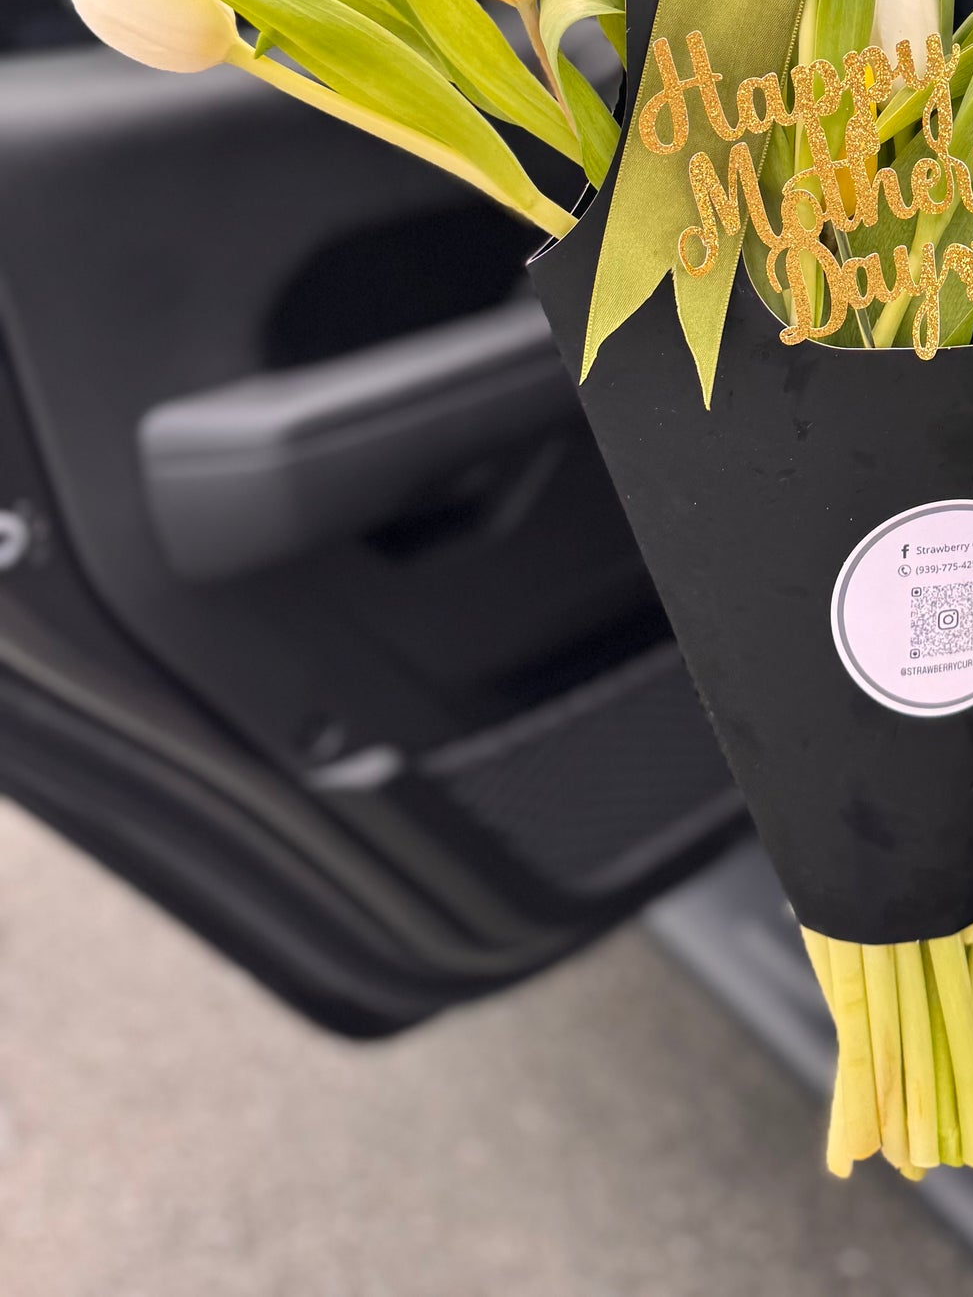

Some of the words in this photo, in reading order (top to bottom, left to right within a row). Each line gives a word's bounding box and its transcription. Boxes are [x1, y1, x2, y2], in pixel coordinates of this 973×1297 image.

[638, 30, 960, 155] Happy
[766, 237, 950, 360] Day
[915, 543, 970, 555] Strawberry
